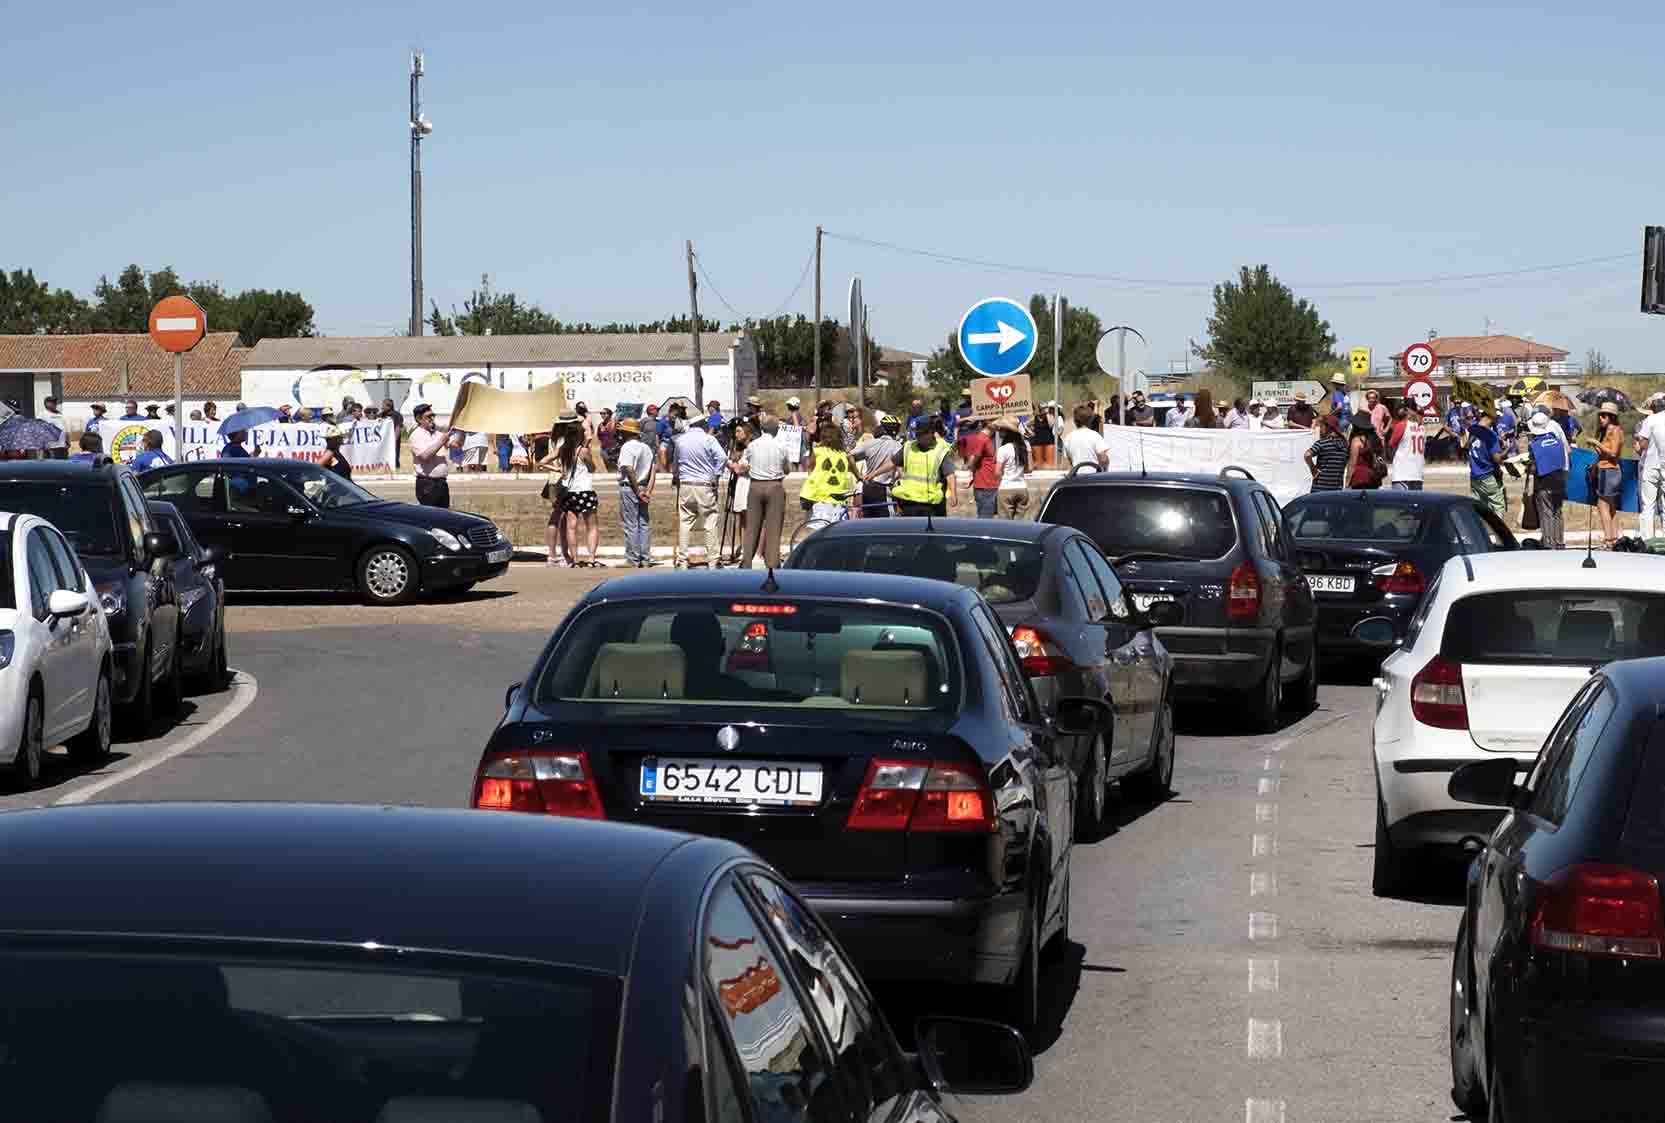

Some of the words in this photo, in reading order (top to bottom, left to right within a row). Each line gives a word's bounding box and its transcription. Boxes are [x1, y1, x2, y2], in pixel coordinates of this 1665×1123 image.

[1410, 354, 1429, 366] 70
[990, 385, 1013, 398] YO
[295, 429, 321, 447] DE
[1412, 434, 1425, 455] 10
[1310, 576, 1324, 589] 96
[1327, 576, 1351, 590] KBD
[646, 780, 654, 789] E
[663, 763, 742, 793] 6542
[754, 766, 813, 796] CDL
